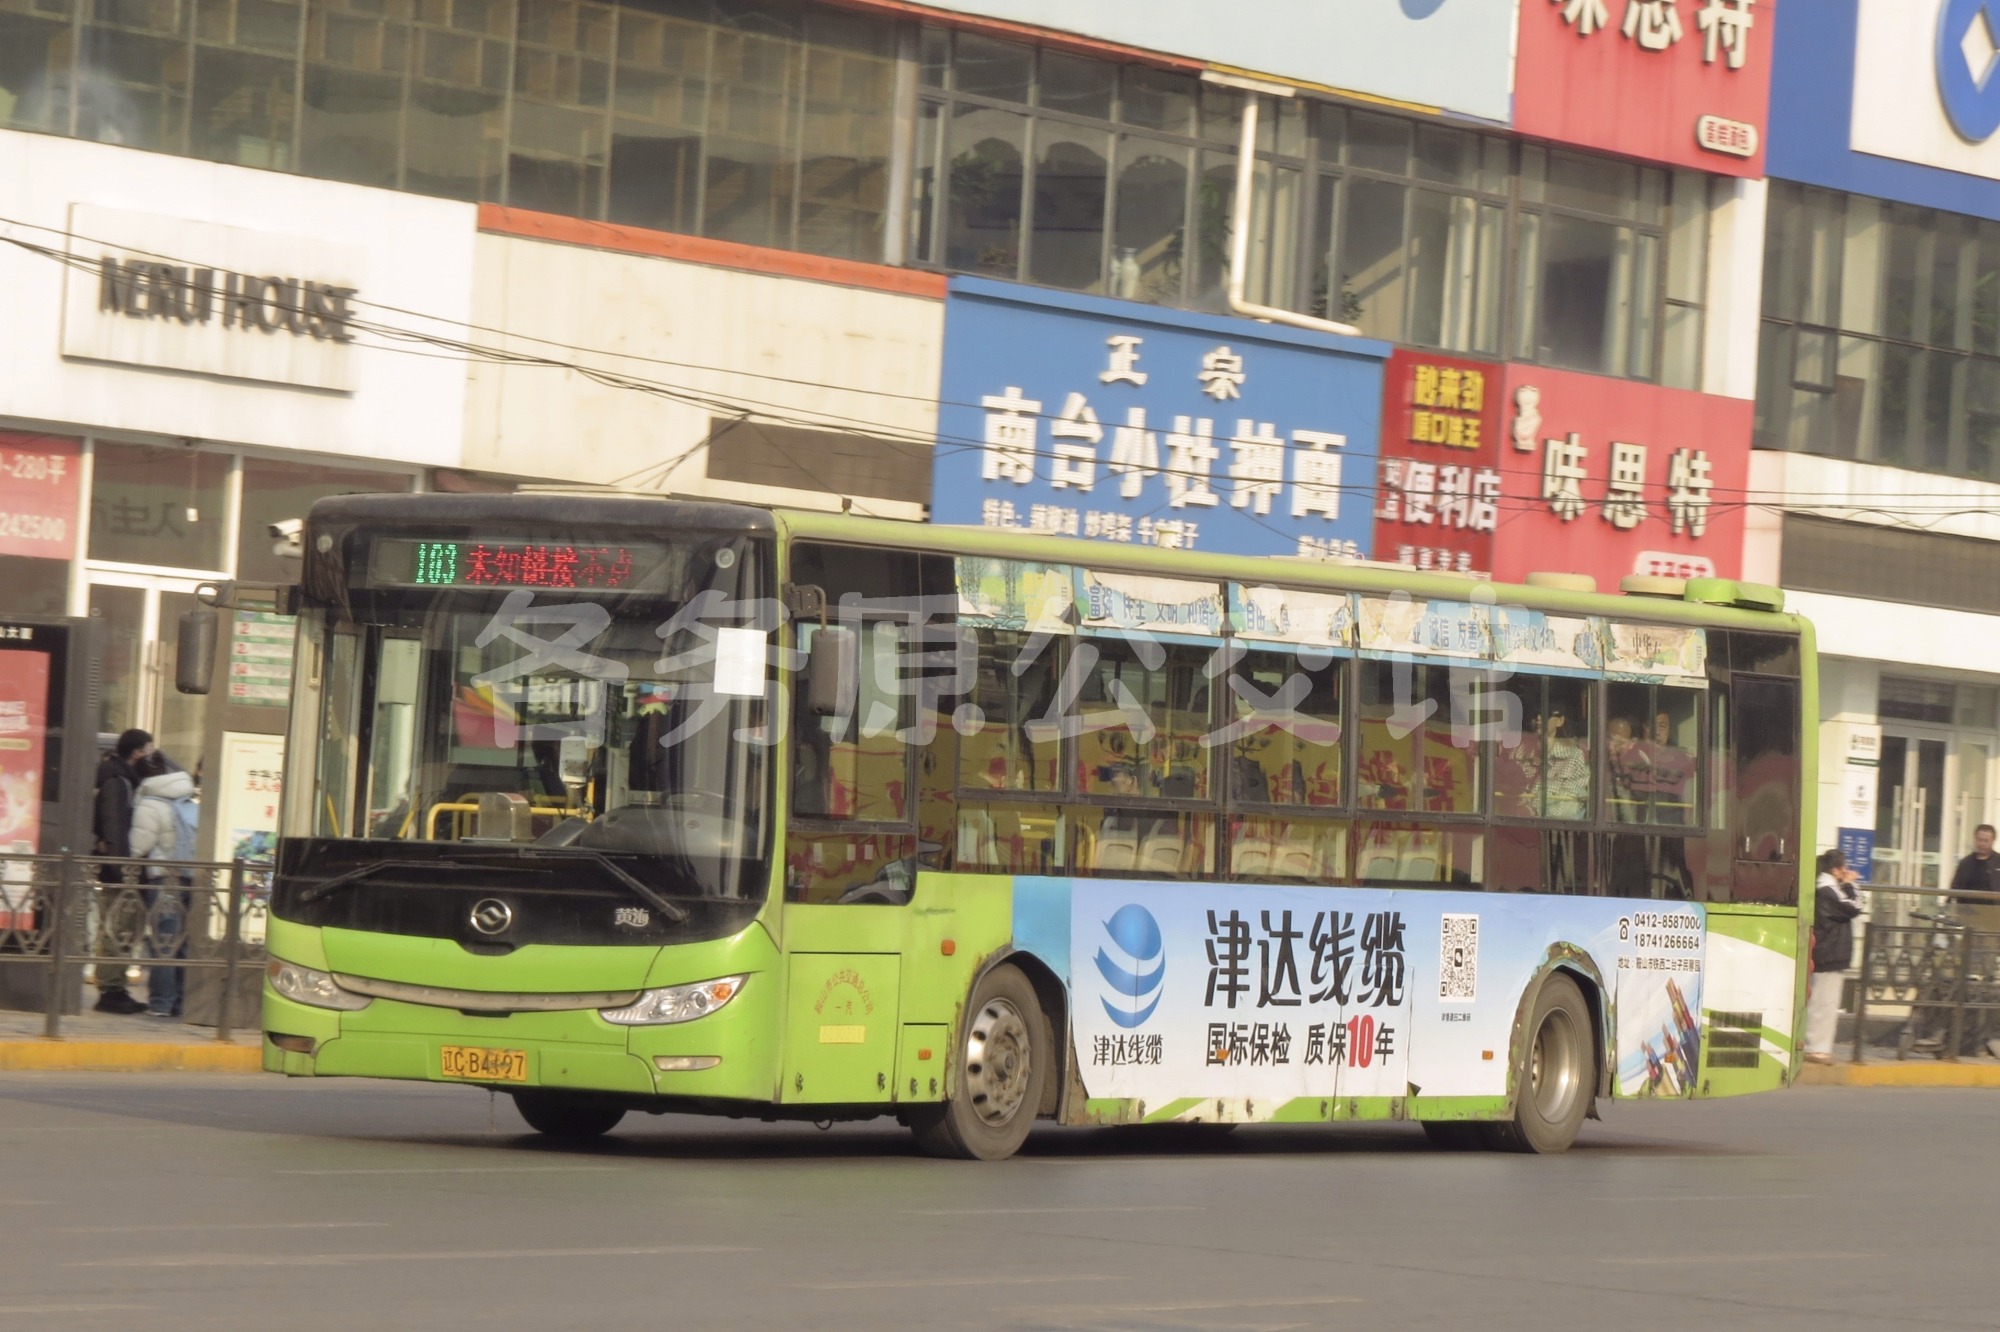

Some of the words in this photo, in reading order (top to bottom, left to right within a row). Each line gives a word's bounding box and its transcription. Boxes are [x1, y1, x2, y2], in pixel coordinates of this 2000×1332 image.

[223, 272, 358, 343] HOUSE
[1100, 335, 1246, 401] 正宗
[0, 453, 66, 486] -280平
[1403, 460, 1502, 533] 便利店
[1204, 910, 1406, 1008] 津达线缆
[1093, 1034, 1163, 1066] 津达线缆
[1206, 1021, 1292, 1067] 国标保检
[1303, 1014, 1395, 1069] 质保10年
